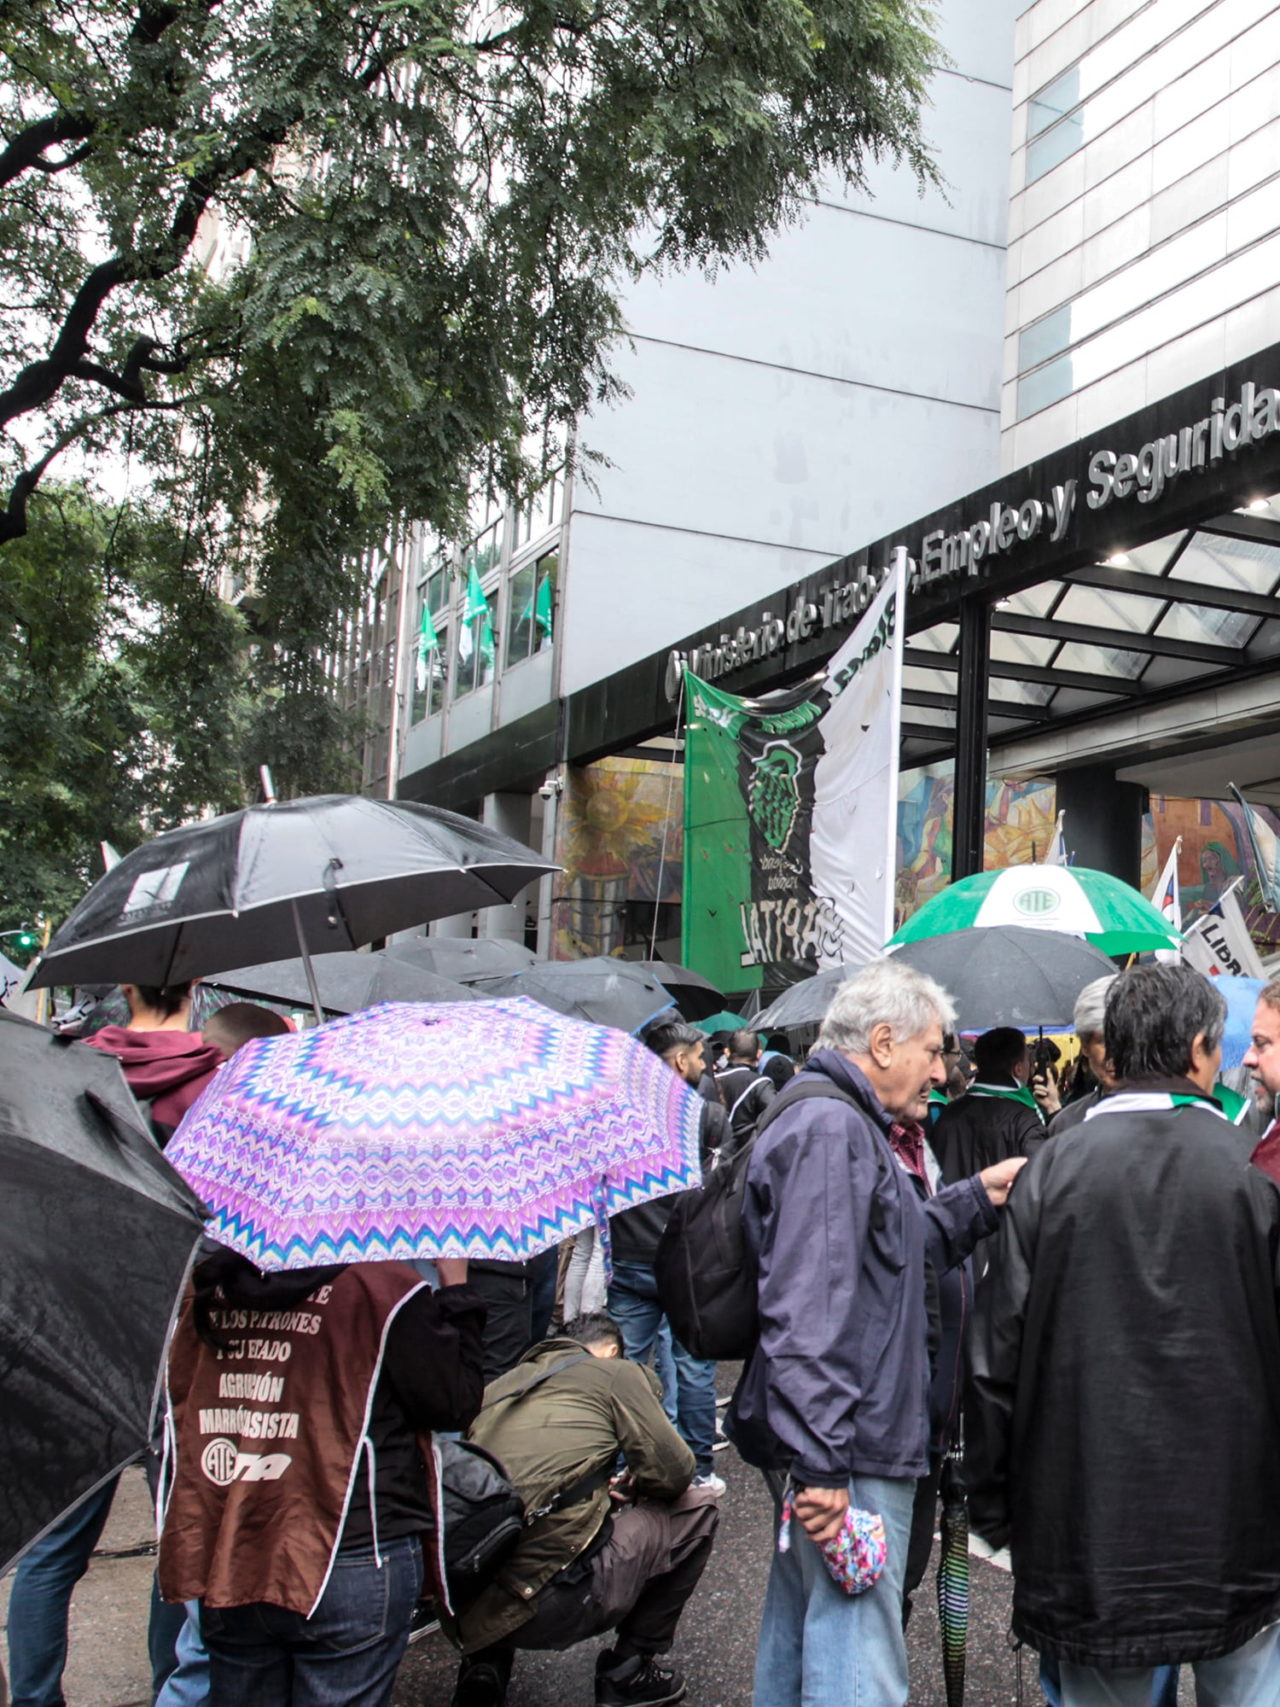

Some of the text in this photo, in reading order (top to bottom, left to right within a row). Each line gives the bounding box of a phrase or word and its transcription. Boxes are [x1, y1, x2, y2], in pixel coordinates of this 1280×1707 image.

[688, 611, 785, 680] Ministerio
[787, 596, 819, 643] de
[820, 550, 918, 628] Trabao,
[921, 499, 1042, 584] Empleo
[1050, 479, 1078, 542] y
[1019, 889, 1056, 912] ATE
[1201, 923, 1249, 978] LIBR
[221, 1310, 248, 1329] LOS
[248, 1339, 292, 1362] ETADO
[219, 1371, 285, 1402] AGRUIÓN
[199, 1404, 247, 1434] MARRÓ
[207, 1443, 235, 1481] ATE
